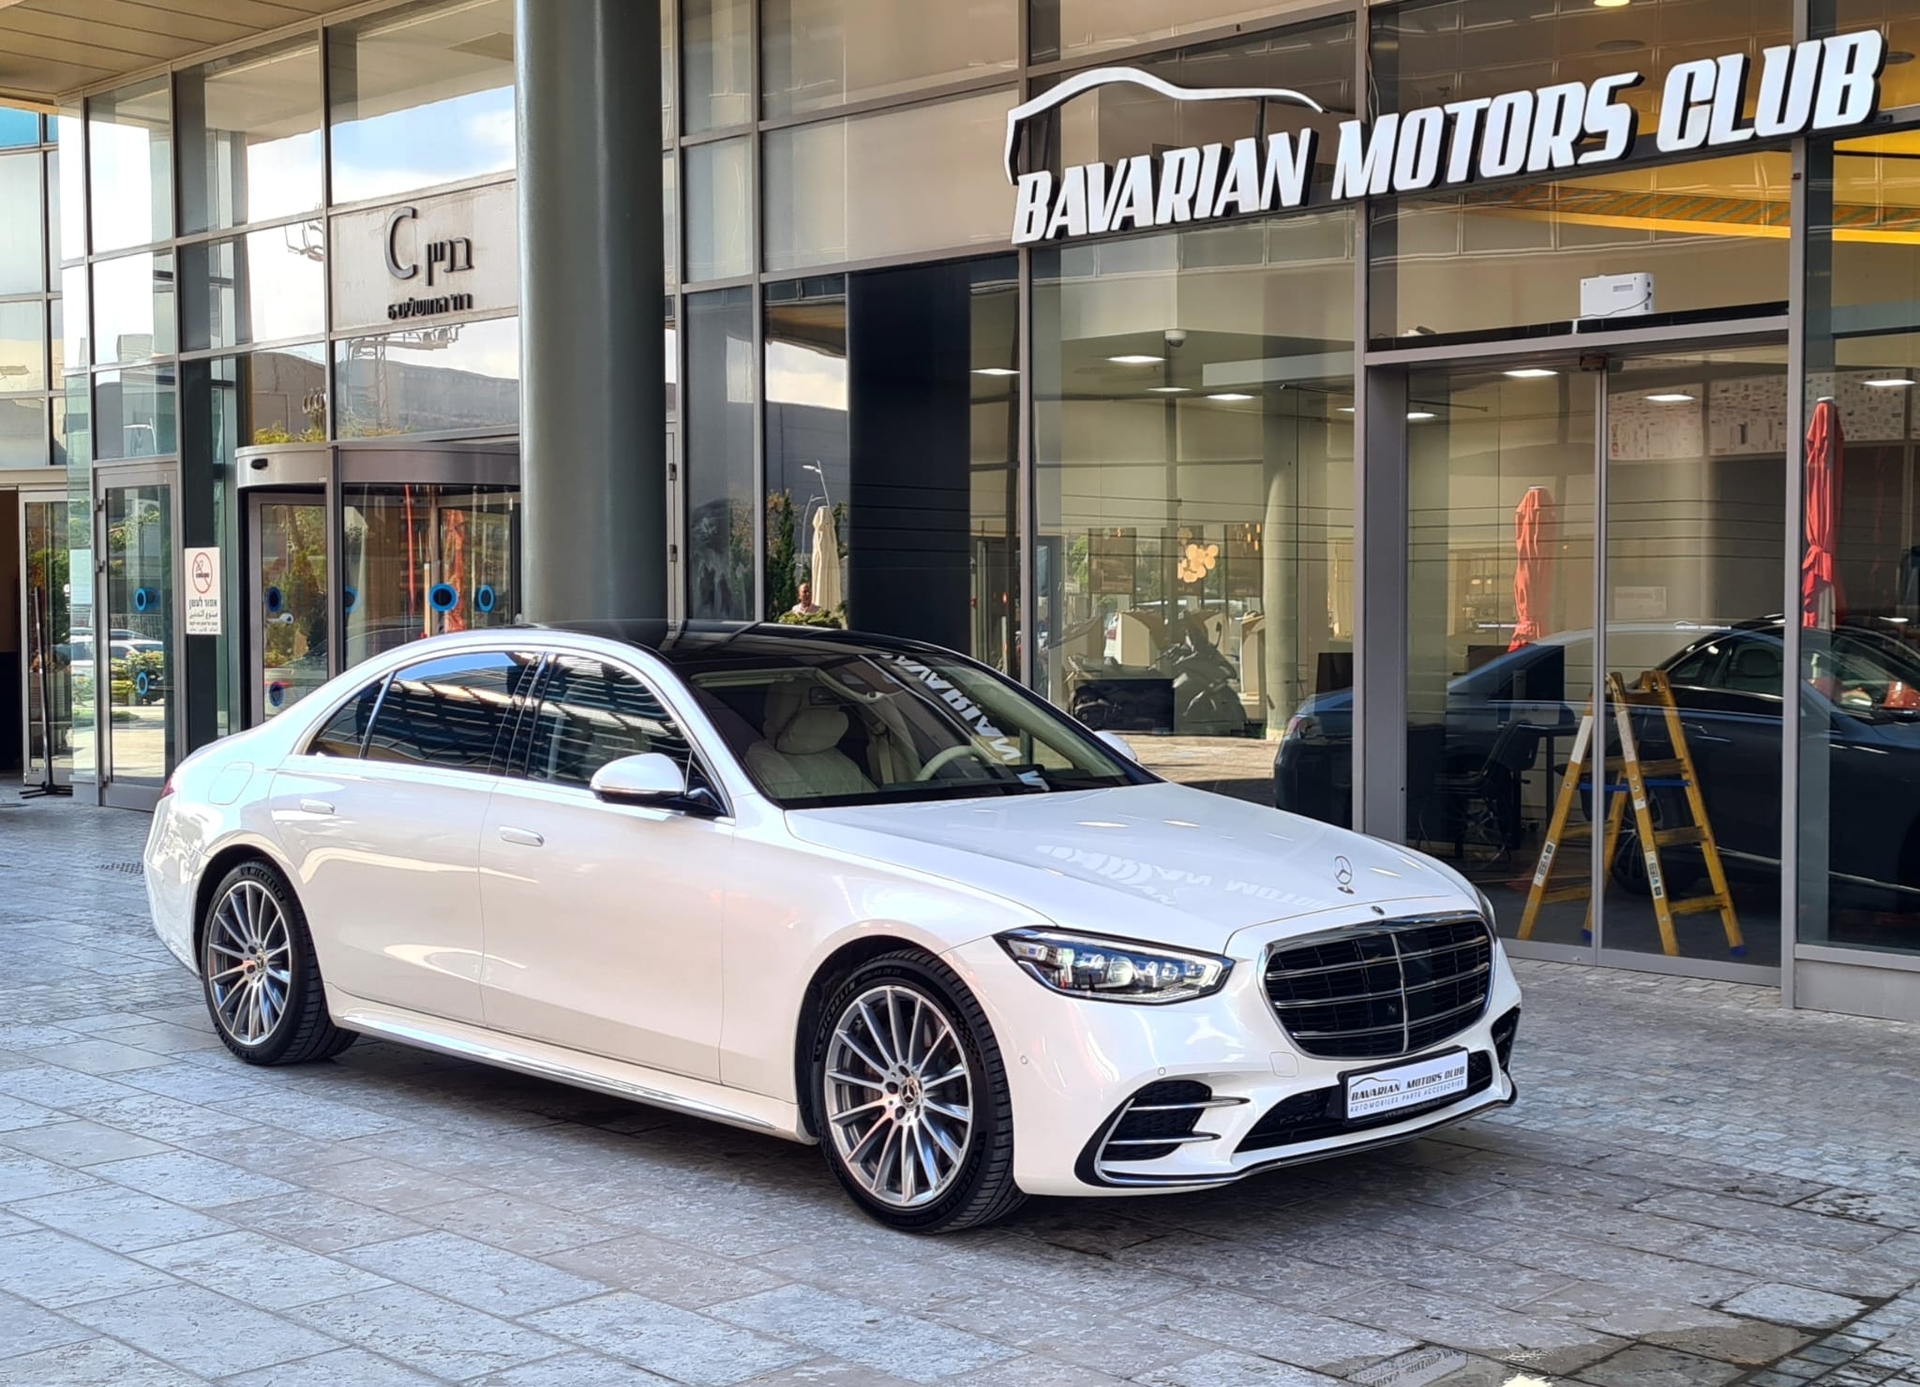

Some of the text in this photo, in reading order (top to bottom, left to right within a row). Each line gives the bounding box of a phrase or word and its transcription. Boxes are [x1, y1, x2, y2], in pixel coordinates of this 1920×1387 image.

[1011, 30, 1886, 246] BAVARIAN MOTORS CLUB
[384, 206, 473, 286] בניין C
[388, 304, 398, 320] 6
[1350, 1096, 1399, 1113] AUTOMOBILES
[1424, 1079, 1464, 1096] ACCESSORIES
[1351, 1065, 1465, 1102] BAVARIAN MOTORS CLUB
